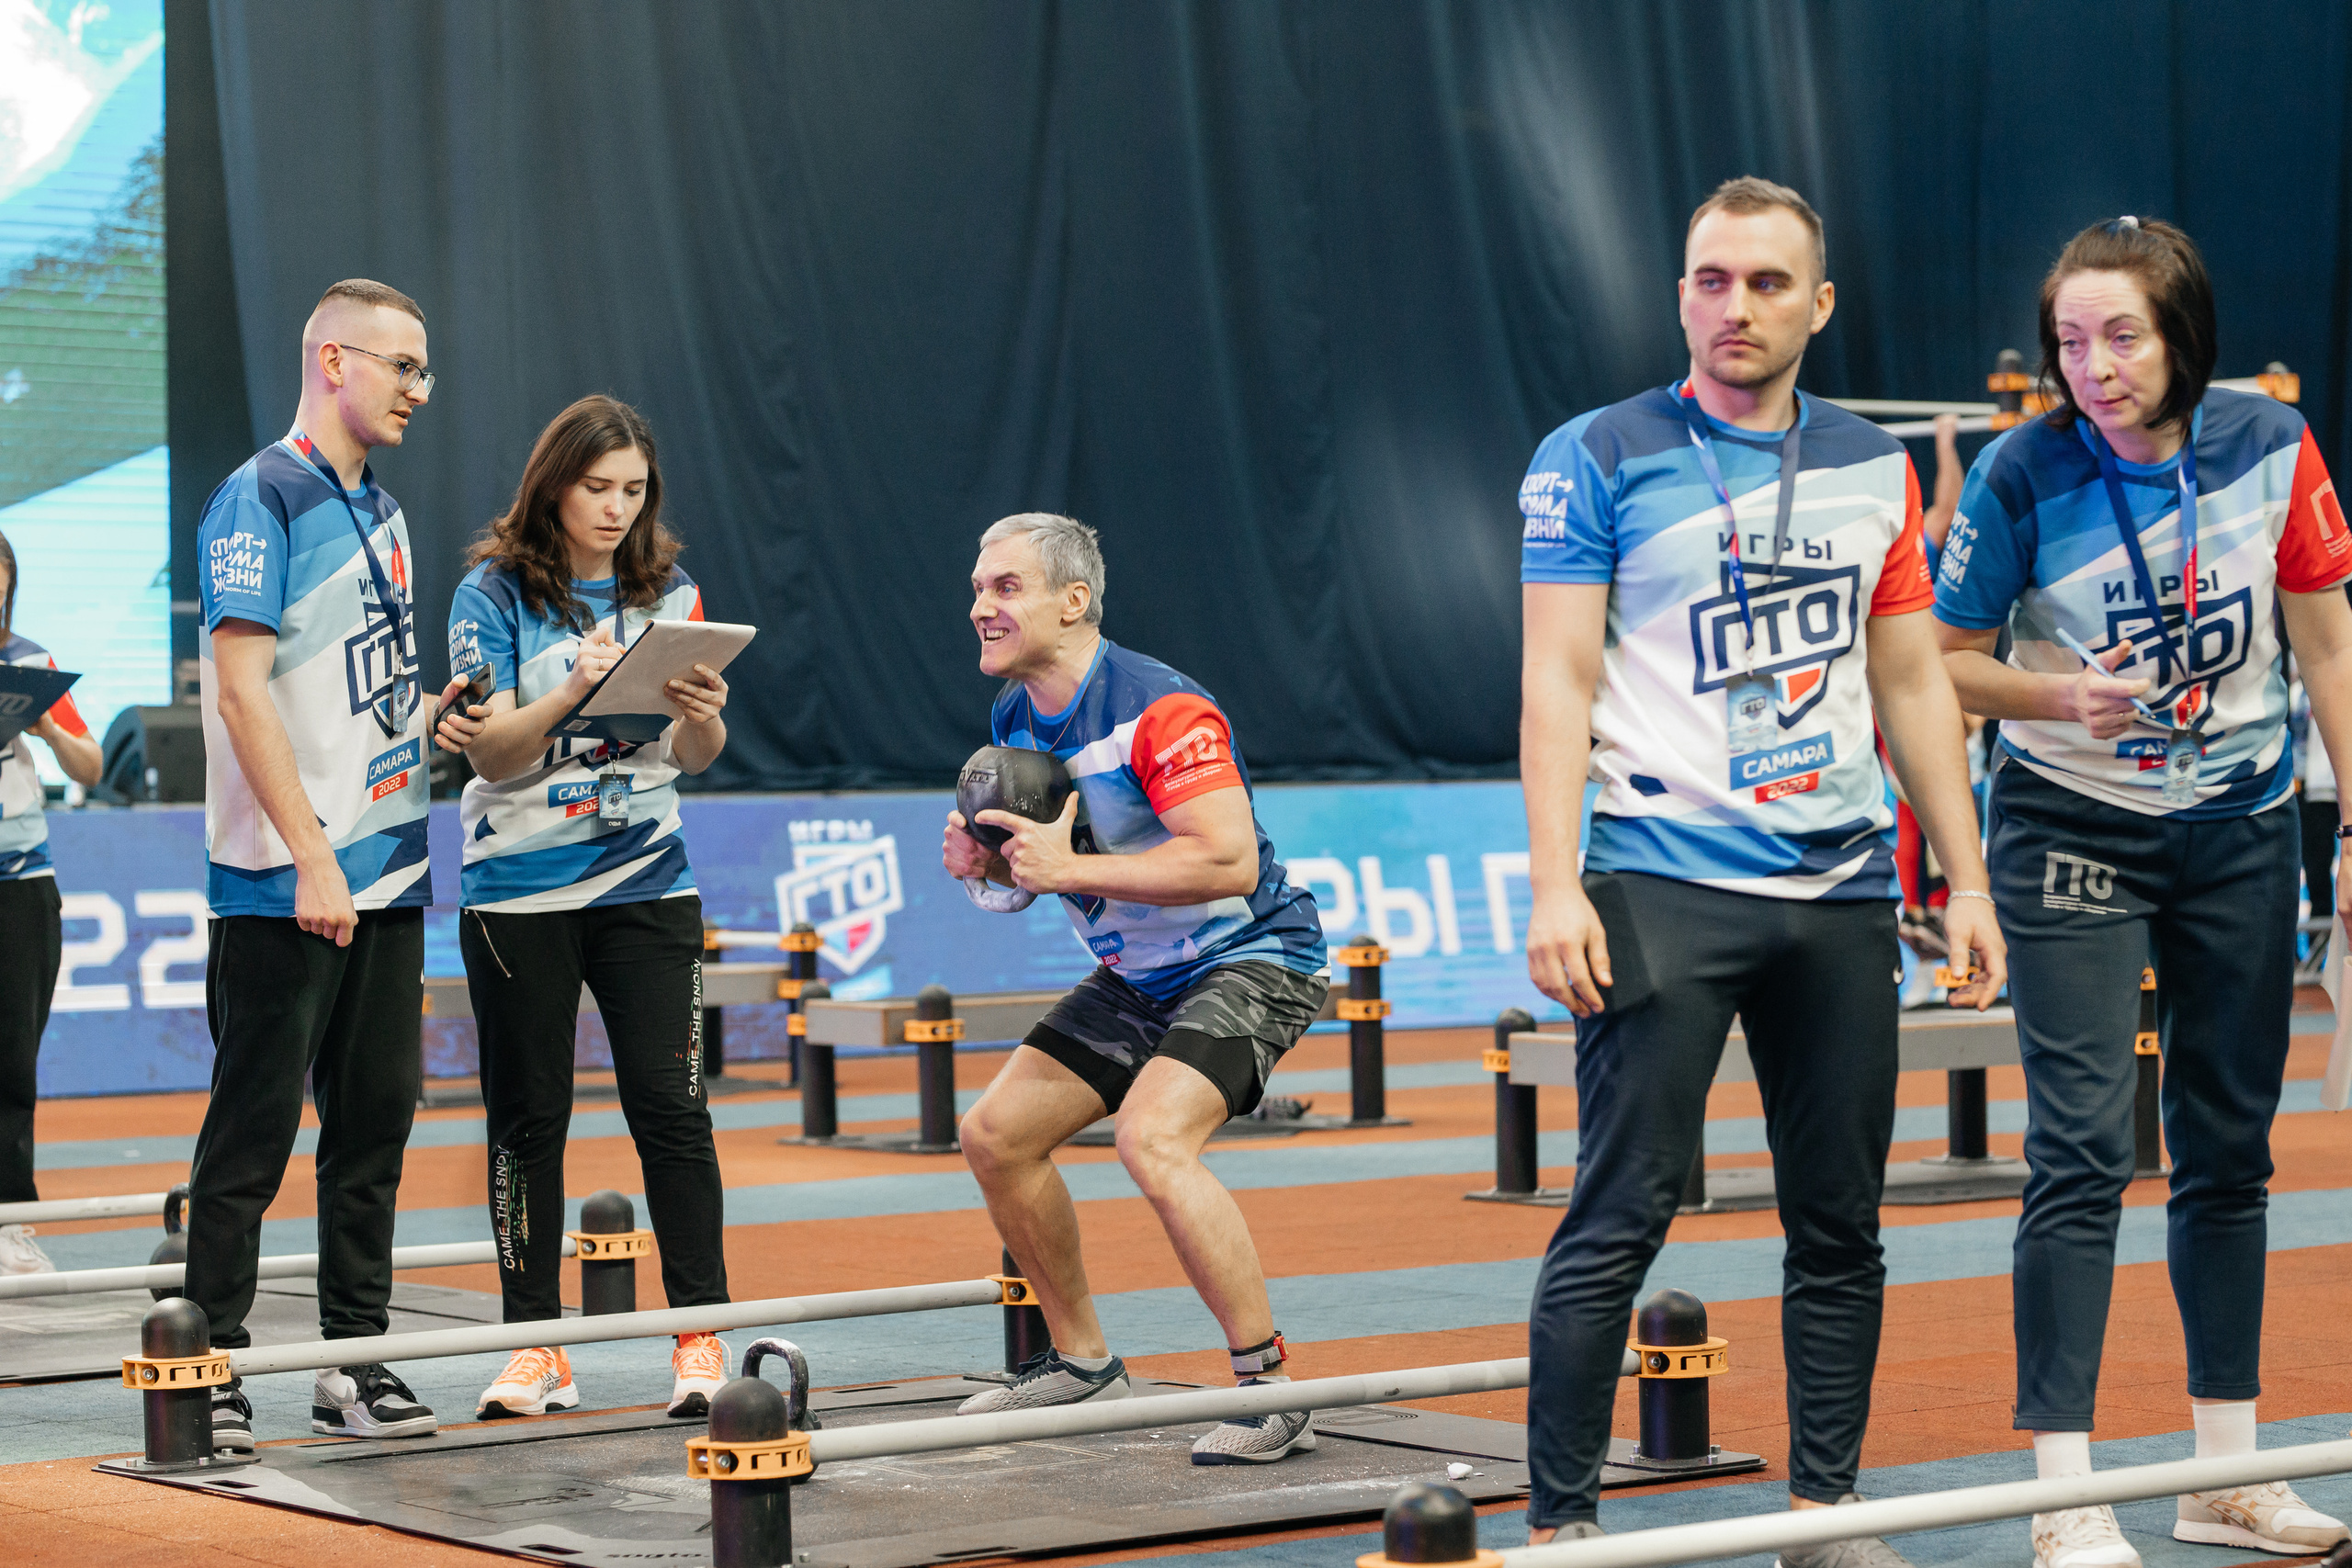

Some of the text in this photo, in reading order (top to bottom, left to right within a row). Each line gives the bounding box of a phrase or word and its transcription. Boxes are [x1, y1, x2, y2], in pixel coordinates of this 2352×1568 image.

[1712, 589, 1839, 671] ГТО
[368, 746, 413, 781] САМАРА
[1743, 742, 1828, 780] САМАРА
[378, 776, 401, 795] 2022
[1766, 776, 1809, 801] 2022
[575, 796, 599, 814] 202
[787, 818, 874, 842] ИГРЫ
[792, 857, 888, 924] ГТО
[2042, 851, 2118, 900] ГТО
[689, 958, 702, 1097] CAME THE SNOW
[495, 1190, 508, 1220] THE
[498, 1225, 515, 1269] CAME
